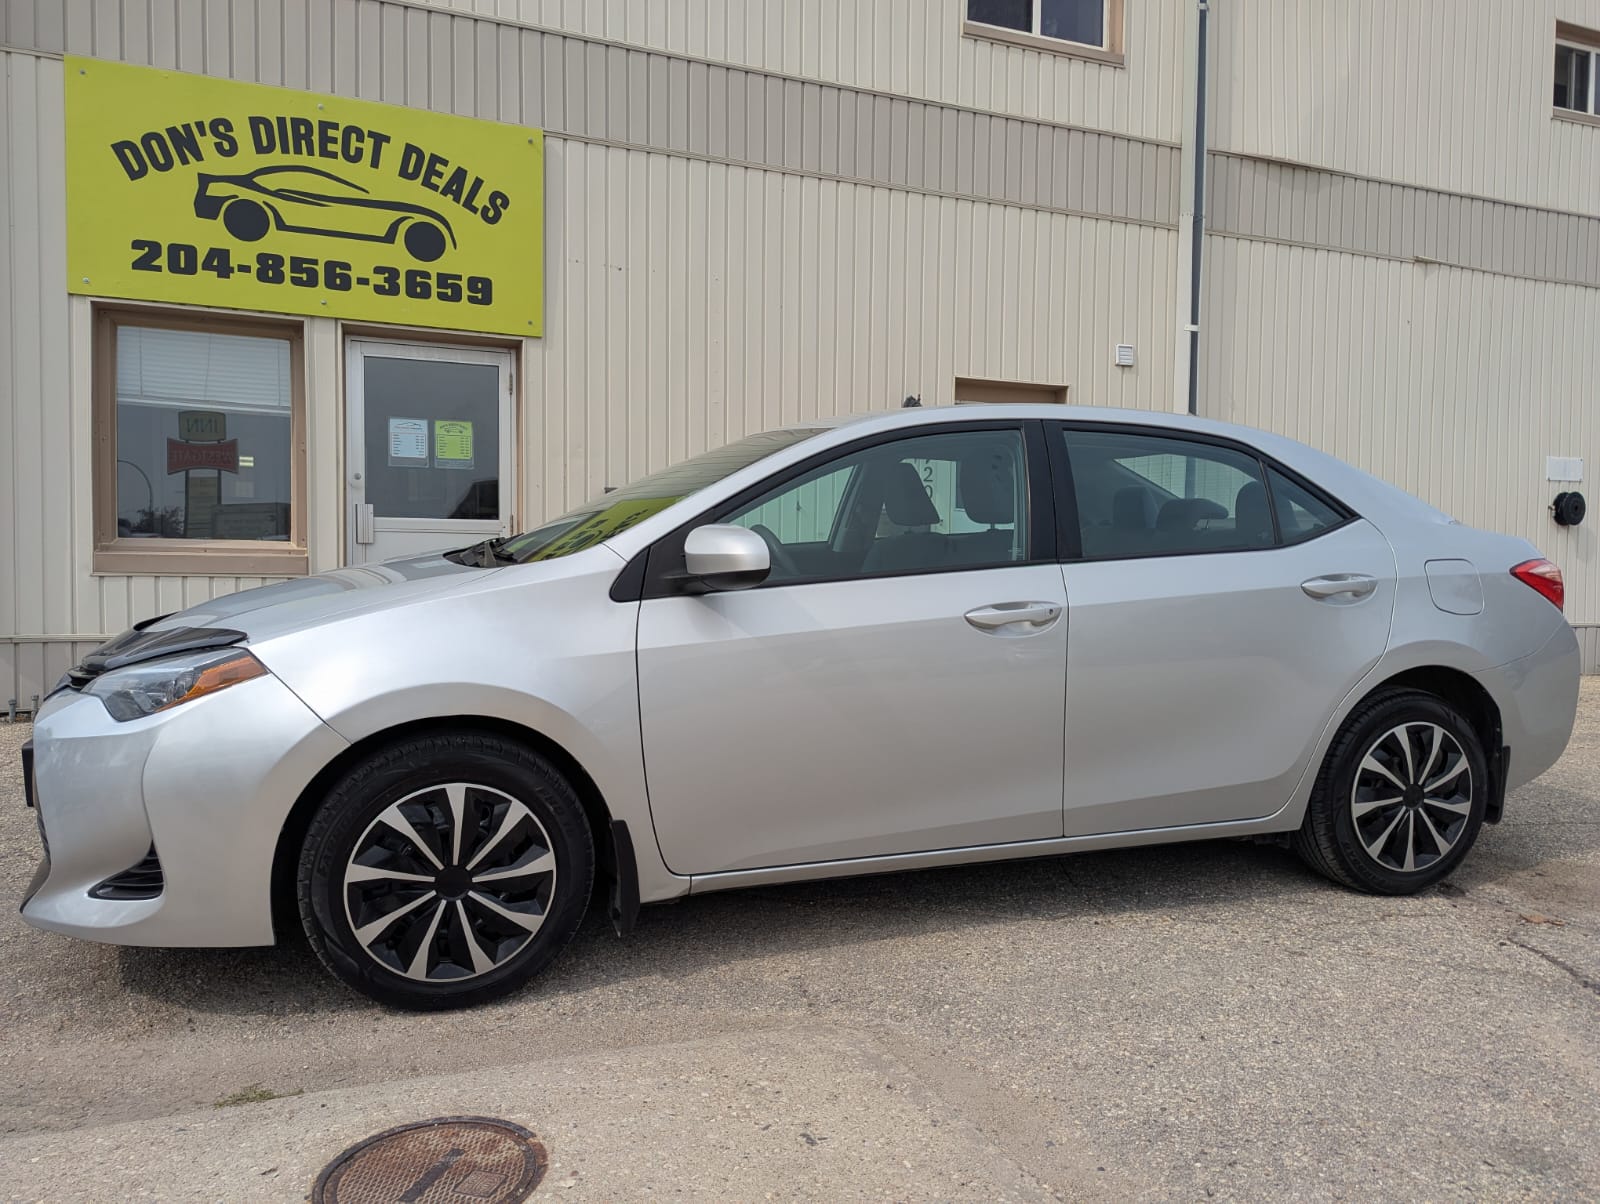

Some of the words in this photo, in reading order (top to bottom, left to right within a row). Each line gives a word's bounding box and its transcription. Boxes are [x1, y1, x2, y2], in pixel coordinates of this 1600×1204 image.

[111, 117, 239, 182] DON'S
[247, 116, 392, 170] DIRECT
[397, 143, 511, 226] DEALS
[131, 239, 493, 306] 204-856-3659
